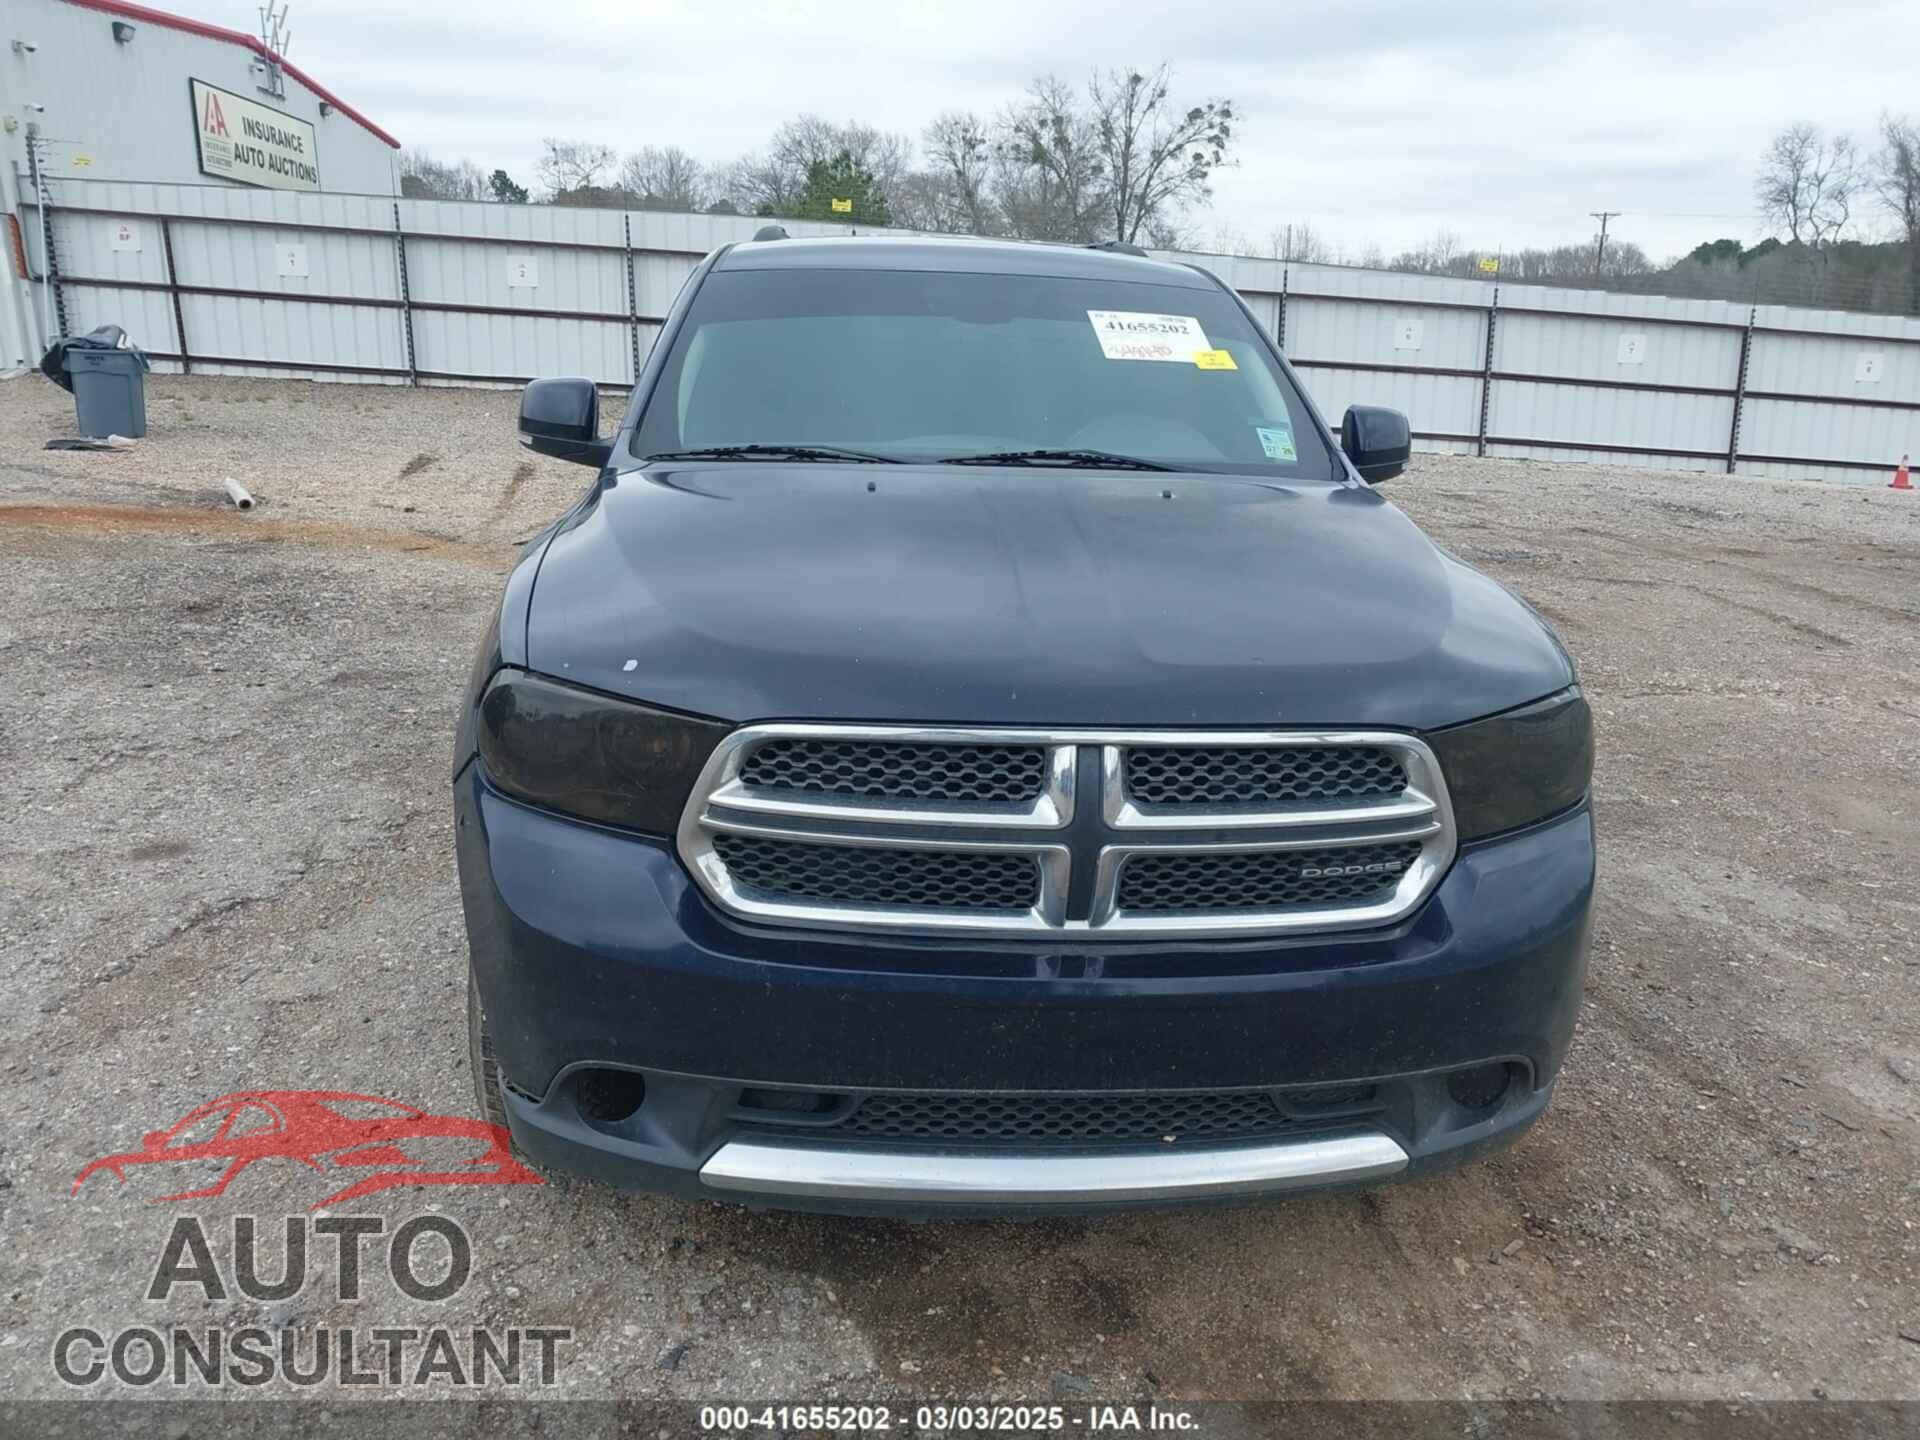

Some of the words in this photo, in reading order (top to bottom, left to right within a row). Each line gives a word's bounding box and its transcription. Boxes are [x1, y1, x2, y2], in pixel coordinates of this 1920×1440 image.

[241, 116, 305, 154] INSURANCE
[233, 142, 266, 169] AUTO
[268, 153, 318, 184] AUCTIONS
[1104, 321, 1191, 335] 41655202
[1301, 861, 1402, 877] DODGE
